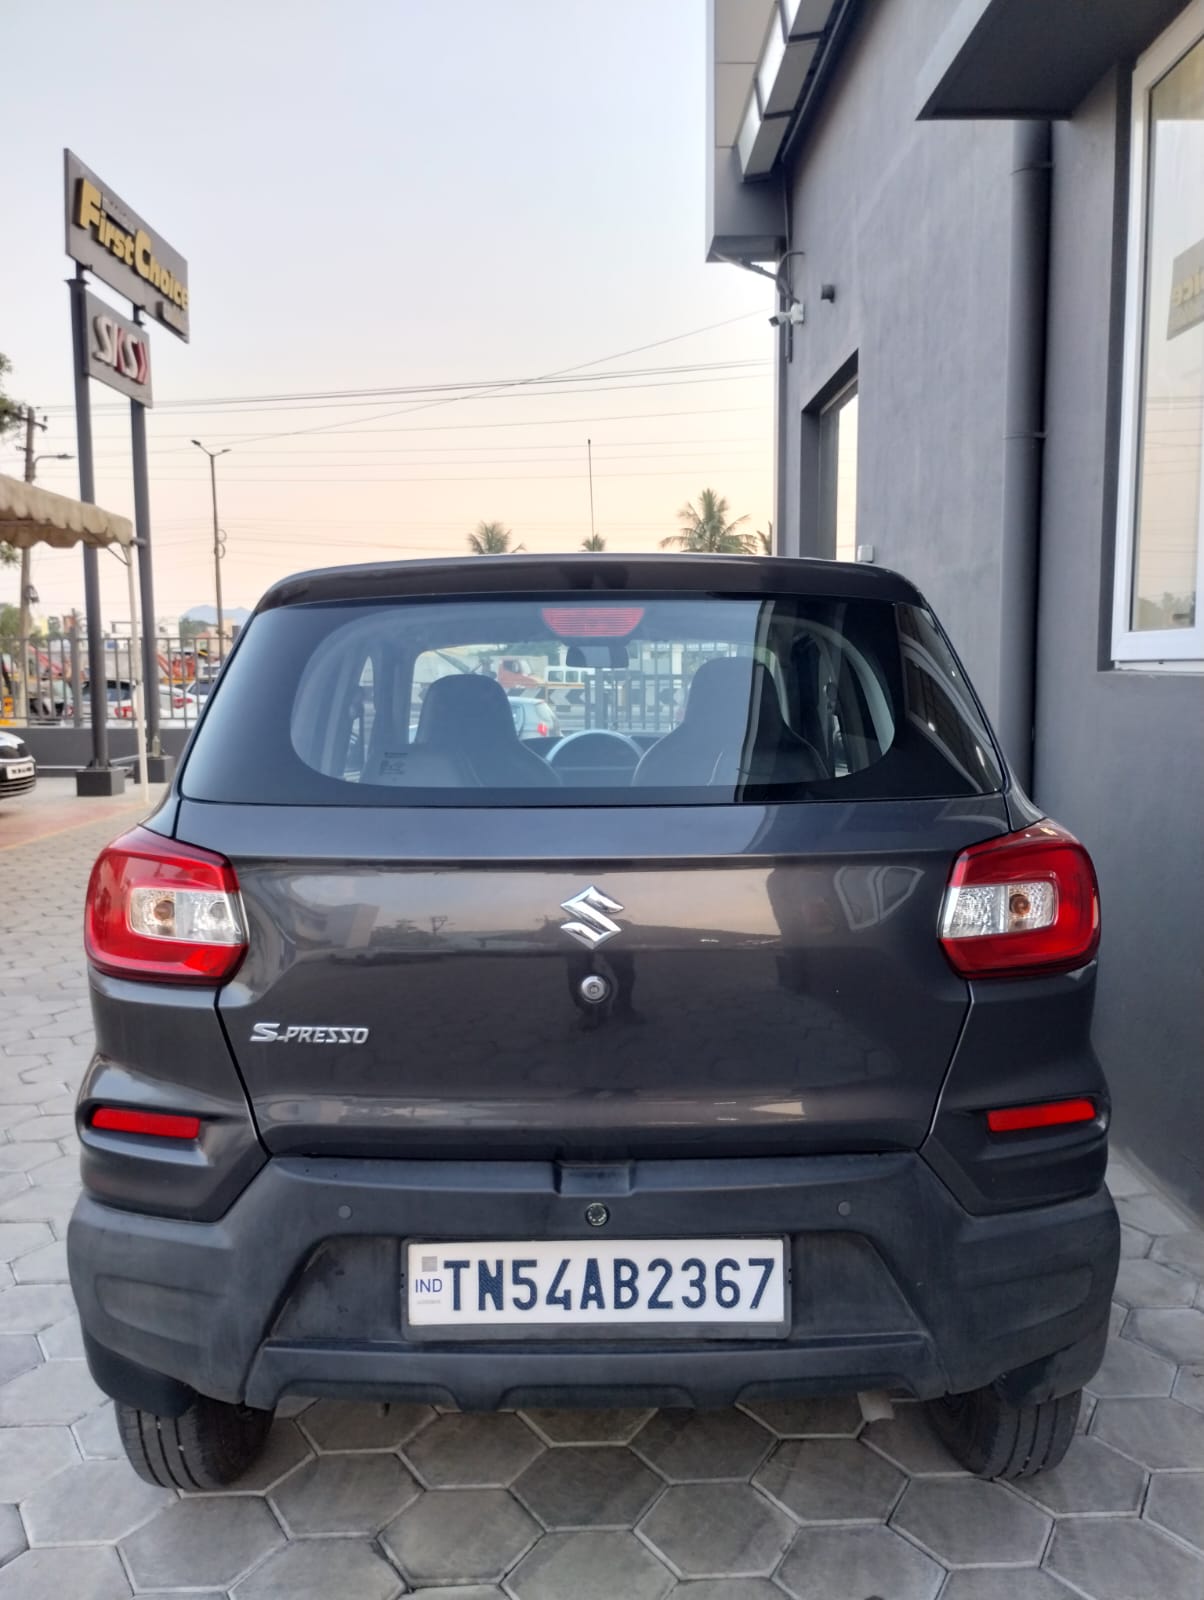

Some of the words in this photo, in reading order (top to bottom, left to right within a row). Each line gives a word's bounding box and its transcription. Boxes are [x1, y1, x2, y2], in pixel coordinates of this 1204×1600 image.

[249, 1022, 369, 1044] S-PRESSO
[415, 1278, 443, 1293] IND
[443, 1257, 775, 1311] TN54AB2367
